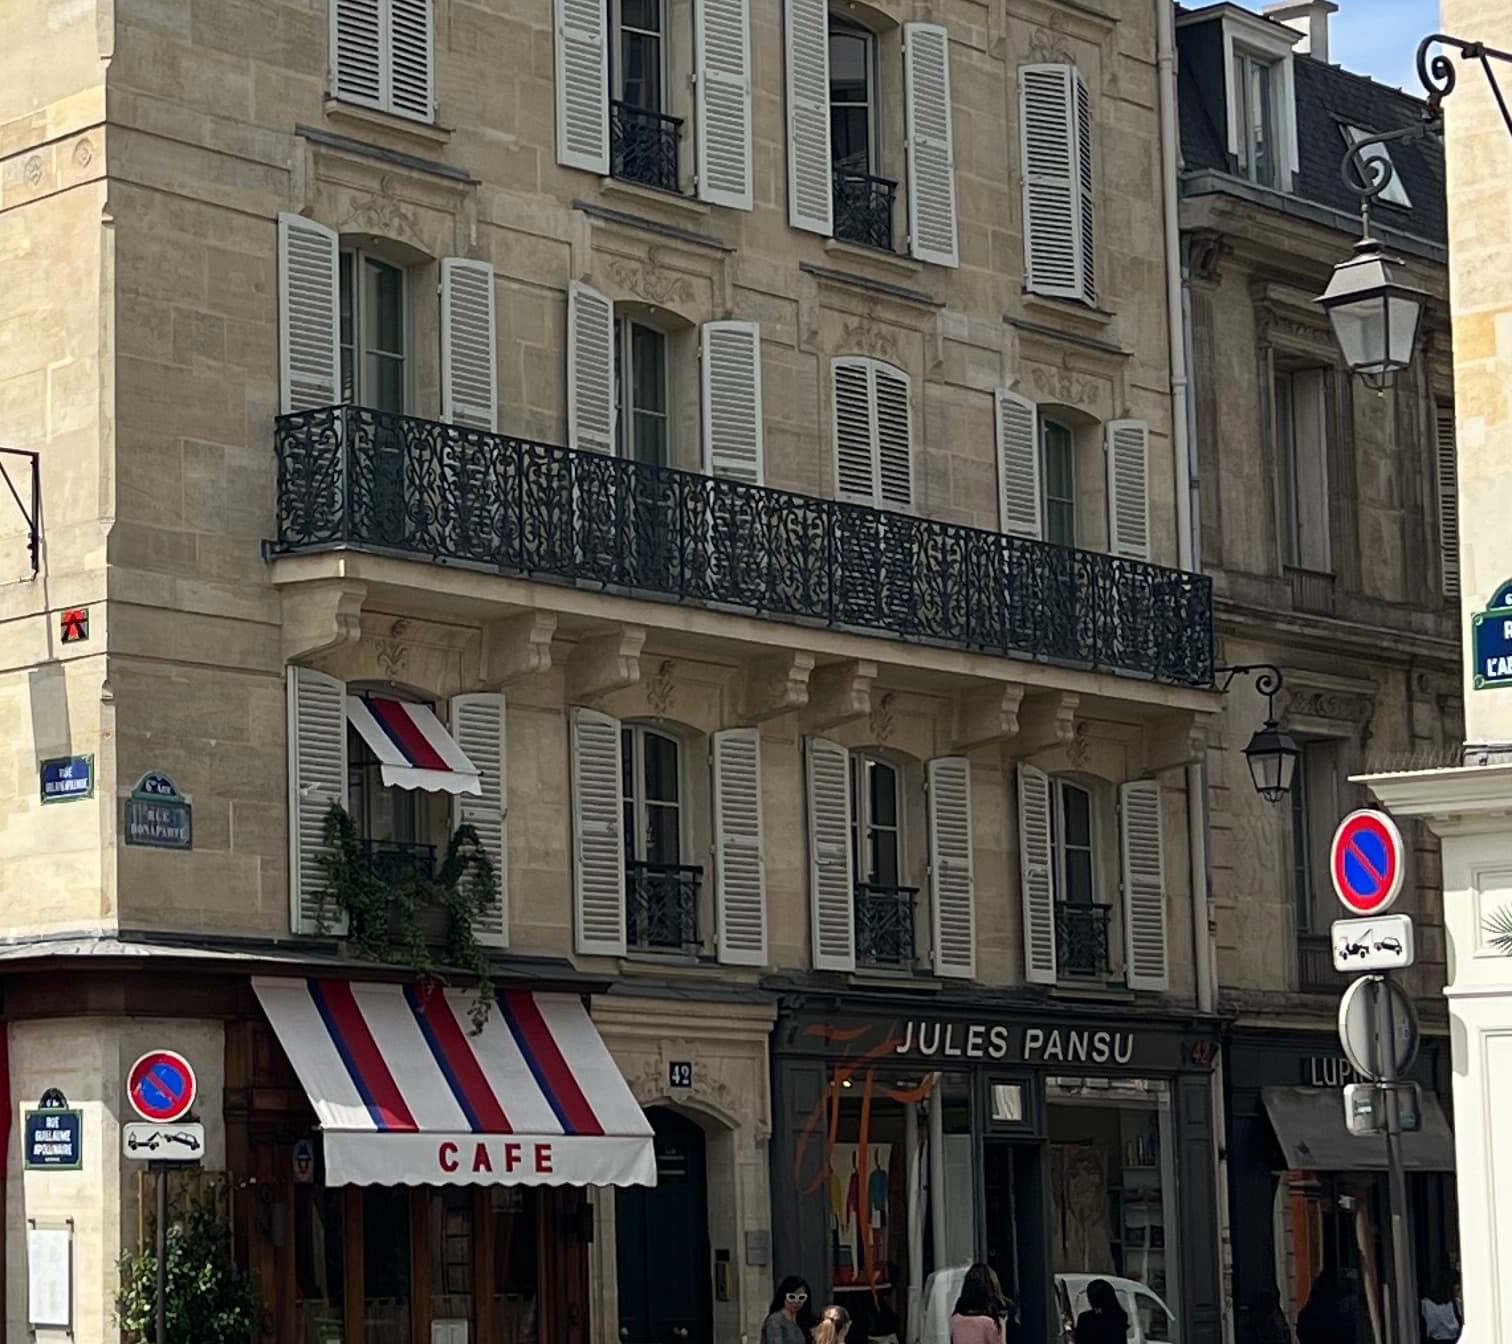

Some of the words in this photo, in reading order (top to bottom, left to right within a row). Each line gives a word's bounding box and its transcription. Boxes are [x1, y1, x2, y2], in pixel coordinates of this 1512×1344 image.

[148, 807, 168, 823] RUE
[130, 823, 185, 839] BONAPARTE
[896, 1021, 1009, 1058] JULES
[1023, 1028, 1134, 1063] PANSU
[671, 1064, 690, 1085] 42
[439, 1141, 553, 1174] CAFE
